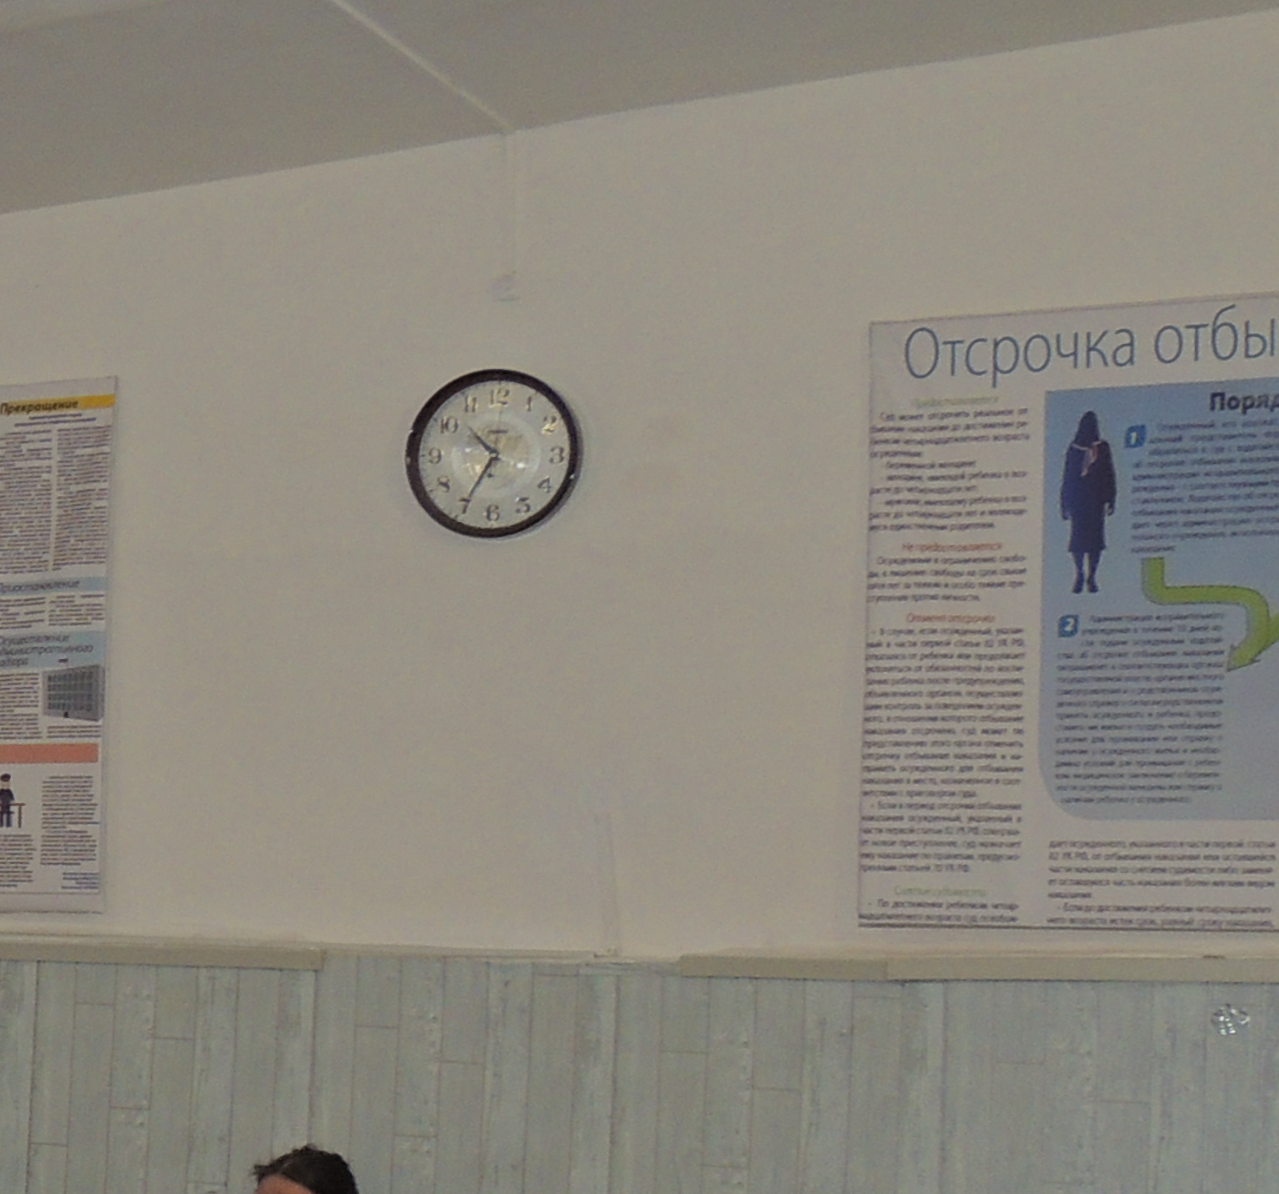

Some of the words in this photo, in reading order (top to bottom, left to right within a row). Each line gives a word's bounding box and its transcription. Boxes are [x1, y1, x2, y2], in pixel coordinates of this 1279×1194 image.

[904, 327, 1135, 388] Отсрочка
[464, 395, 477, 413] 11
[490, 388, 510, 406] 12
[0, 401, 79, 416] Прекращение
[440, 416, 459, 434] 10
[542, 415, 557, 434] 2
[428, 447, 442, 464] 9
[549, 445, 565, 464] 3
[437, 475, 451, 493] 8
[537, 477, 552, 494] 4
[485, 504, 500, 522] 6
[515, 497, 530, 513] 5
